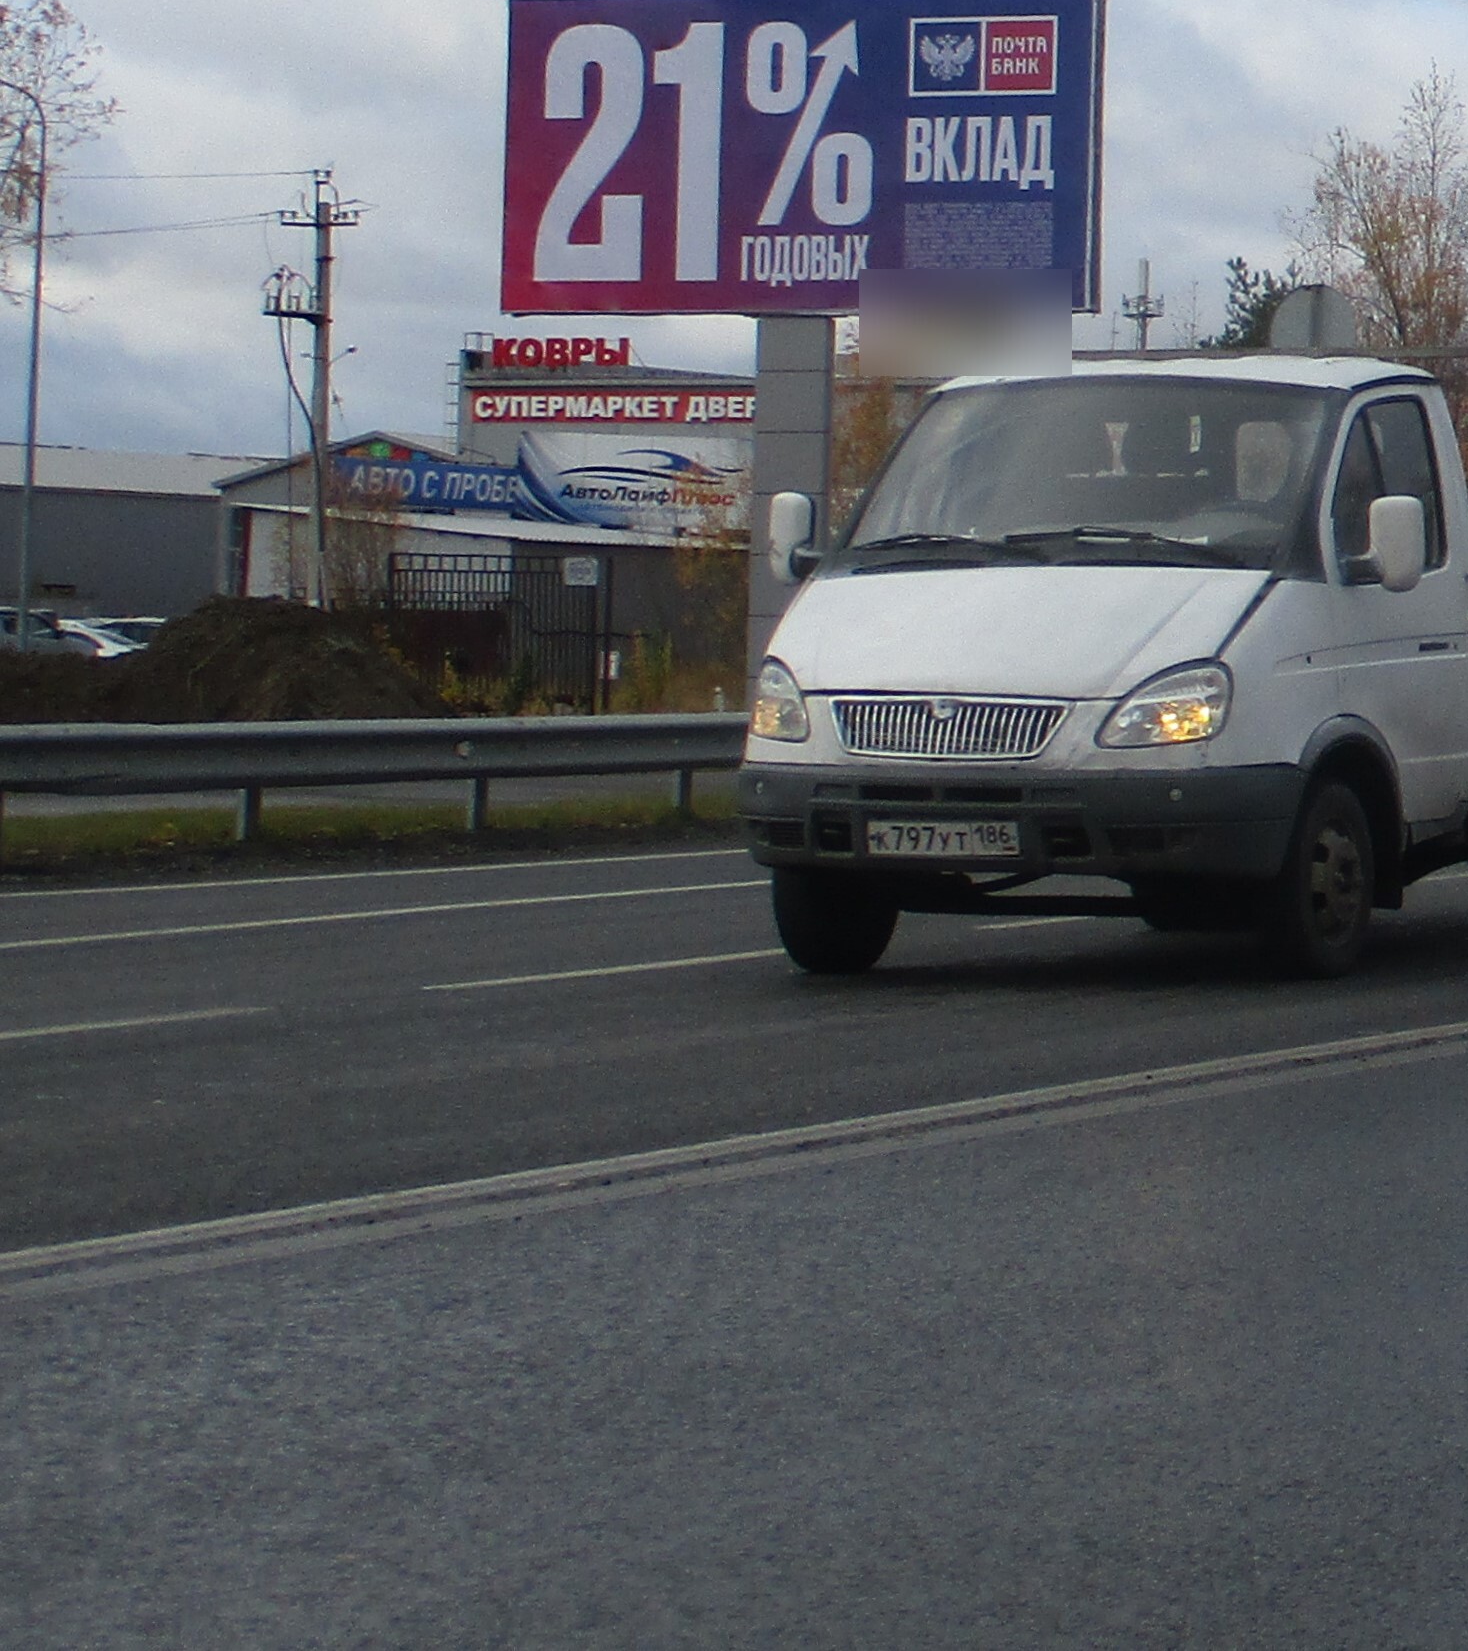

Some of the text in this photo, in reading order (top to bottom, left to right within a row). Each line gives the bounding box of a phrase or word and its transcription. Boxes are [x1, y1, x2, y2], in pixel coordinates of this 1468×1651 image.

[992, 36, 1047, 54] ПОЧТА
[991, 57, 1039, 75] БАНК
[532, 19, 874, 282] 21%
[904, 115, 1055, 190] ВКЛАД
[740, 234, 870, 287] ГОДОВЫХ
[493, 337, 630, 367] КОВРЫ
[474, 395, 679, 419] СУПЕРМАРКЕТ
[349, 464, 416, 497] АВТО
[421, 470, 440, 499] С
[876, 824, 1011, 851] К797УТ 186
